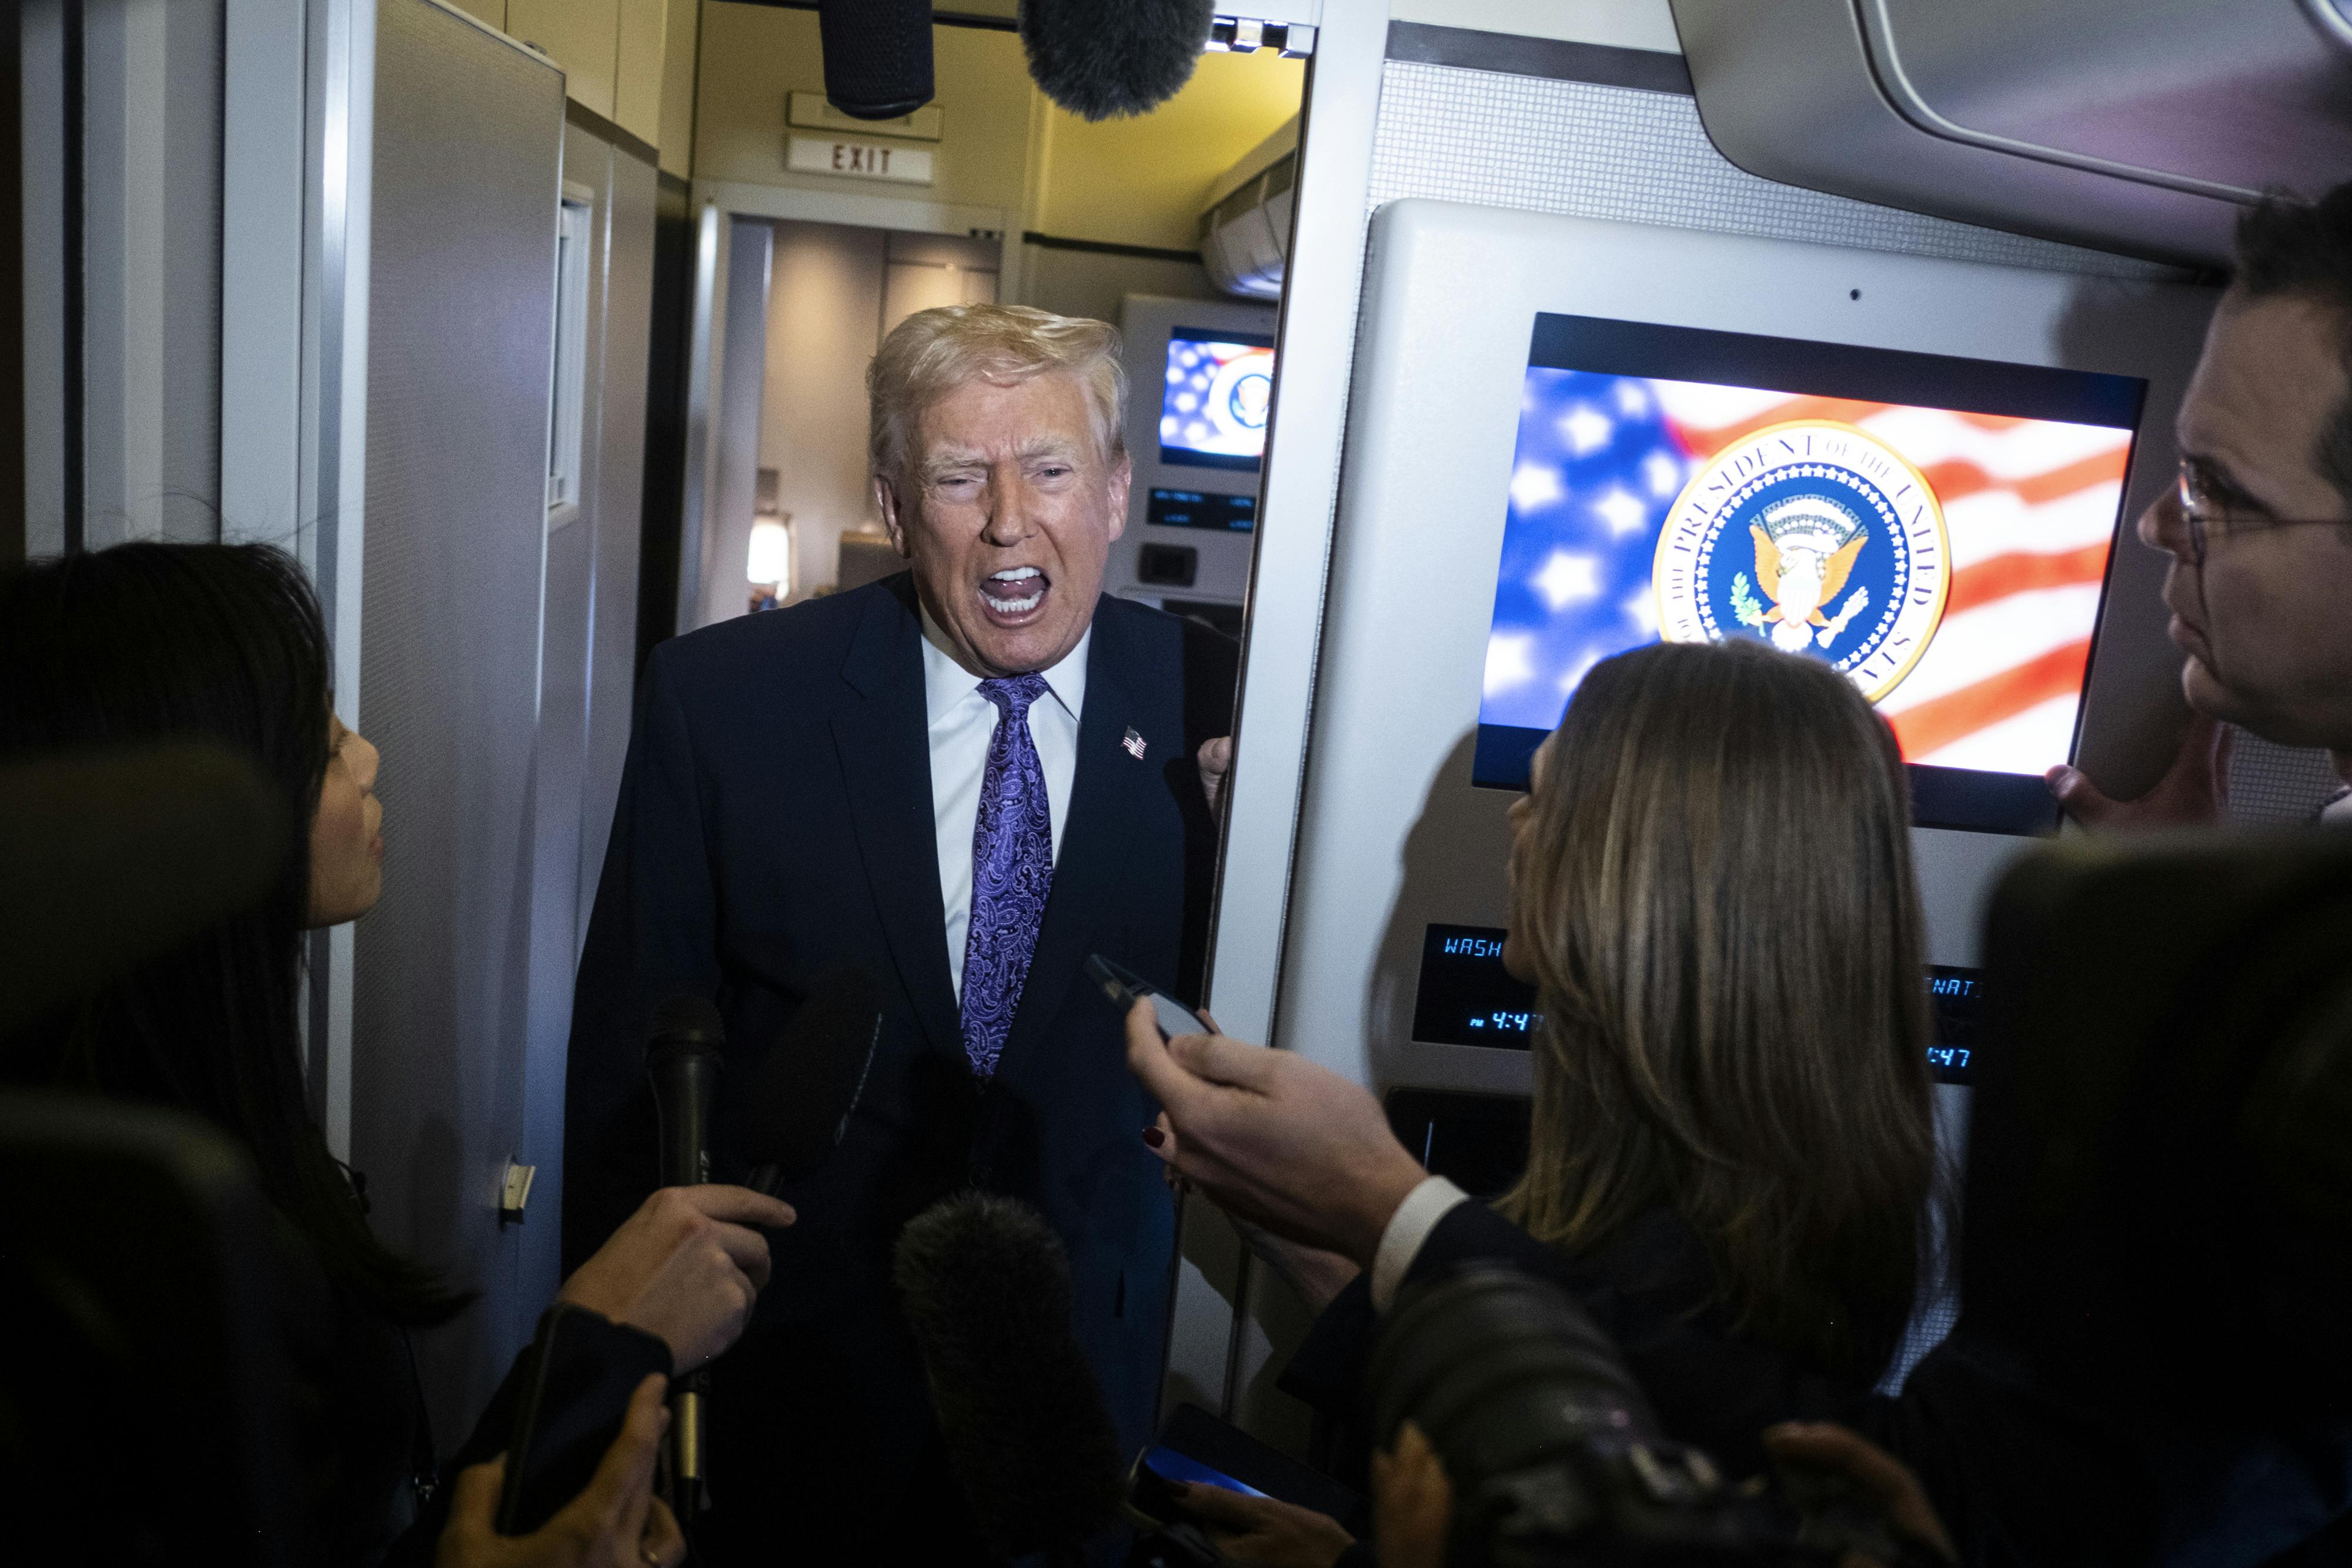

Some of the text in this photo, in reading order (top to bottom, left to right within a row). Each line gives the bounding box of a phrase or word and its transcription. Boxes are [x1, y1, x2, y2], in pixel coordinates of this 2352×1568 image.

[831, 145, 890, 173] EXIT
[1826, 440, 1849, 457] OF
[1857, 450, 1895, 479] THE
[1673, 434, 1819, 553] PRESIDENT
[1896, 483, 1936, 606] UNITED
[1861, 630, 1912, 680] STA
[1444, 938, 1502, 957] WASH
[1926, 978, 1980, 997] NAT
[1469, 1018, 1485, 1028] PM
